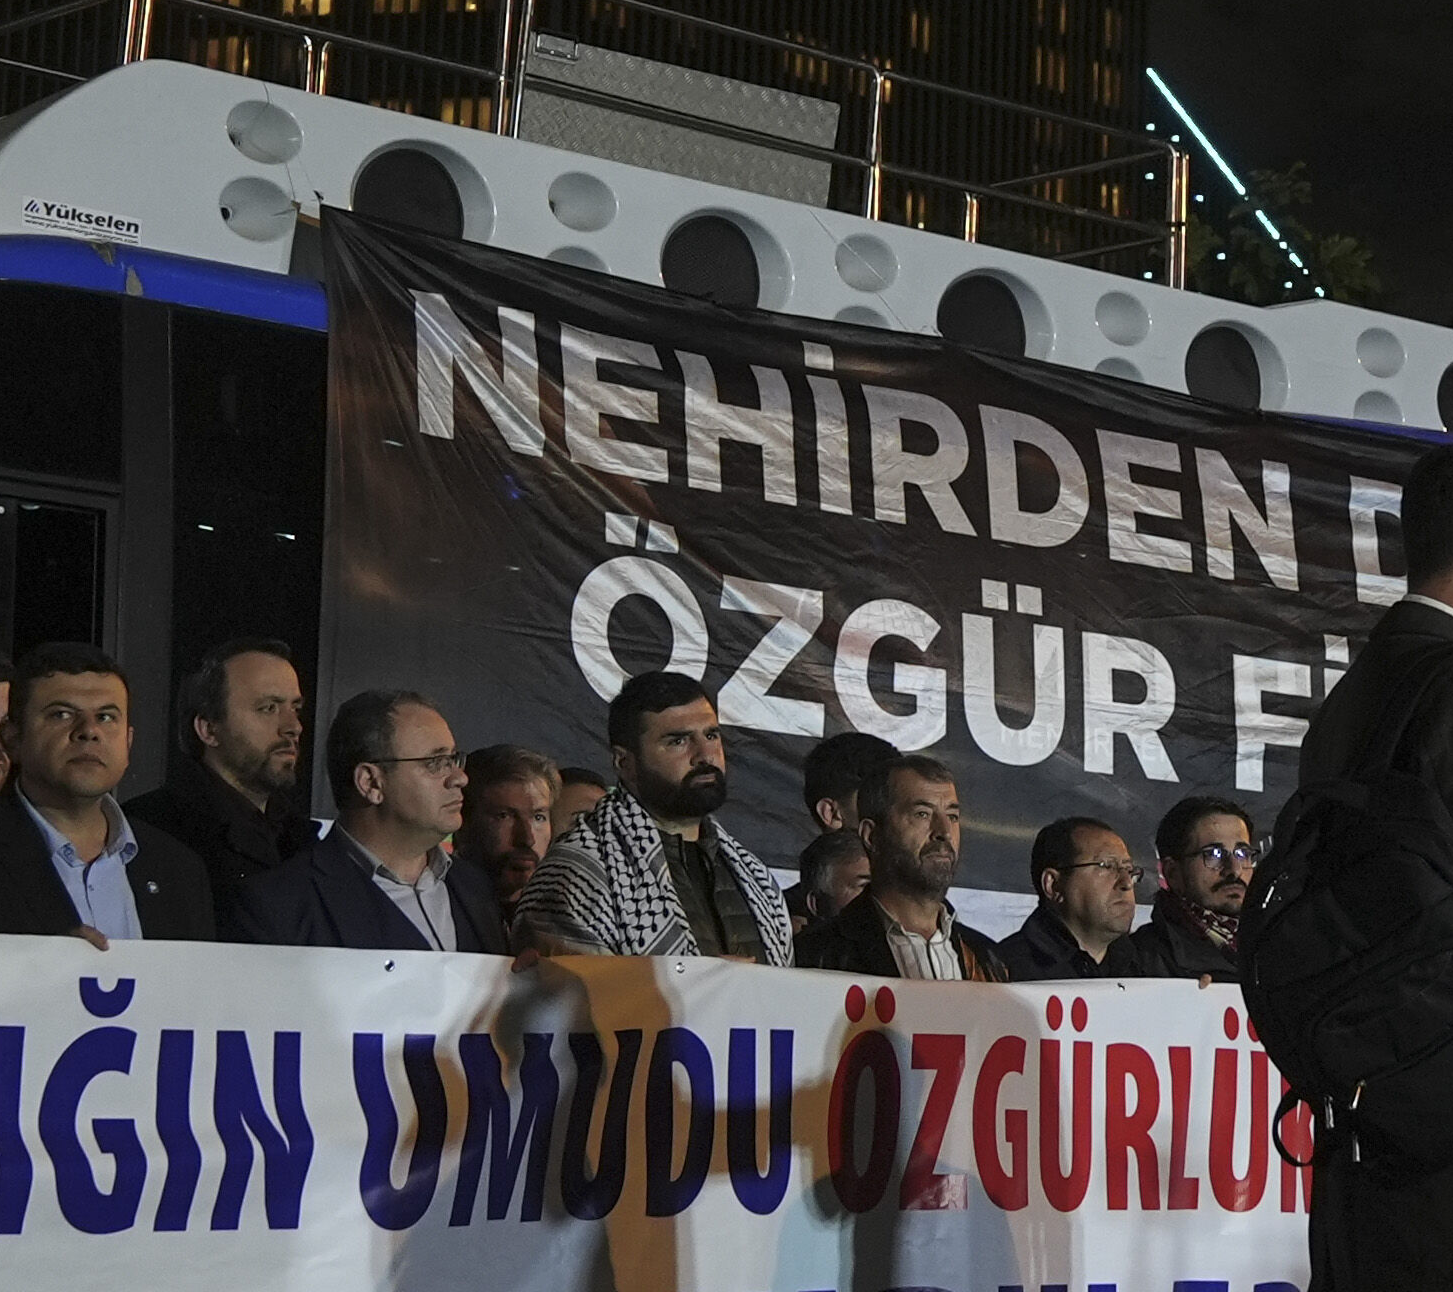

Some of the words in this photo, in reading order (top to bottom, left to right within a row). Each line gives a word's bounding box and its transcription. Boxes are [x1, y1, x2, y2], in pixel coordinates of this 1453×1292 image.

[43, 202, 140, 234] Yükselen
[409, 288, 1300, 592] NEHİRDEN
[571, 514, 1179, 783] ÖZGÜR
[352, 1027, 795, 1232] UMUDU
